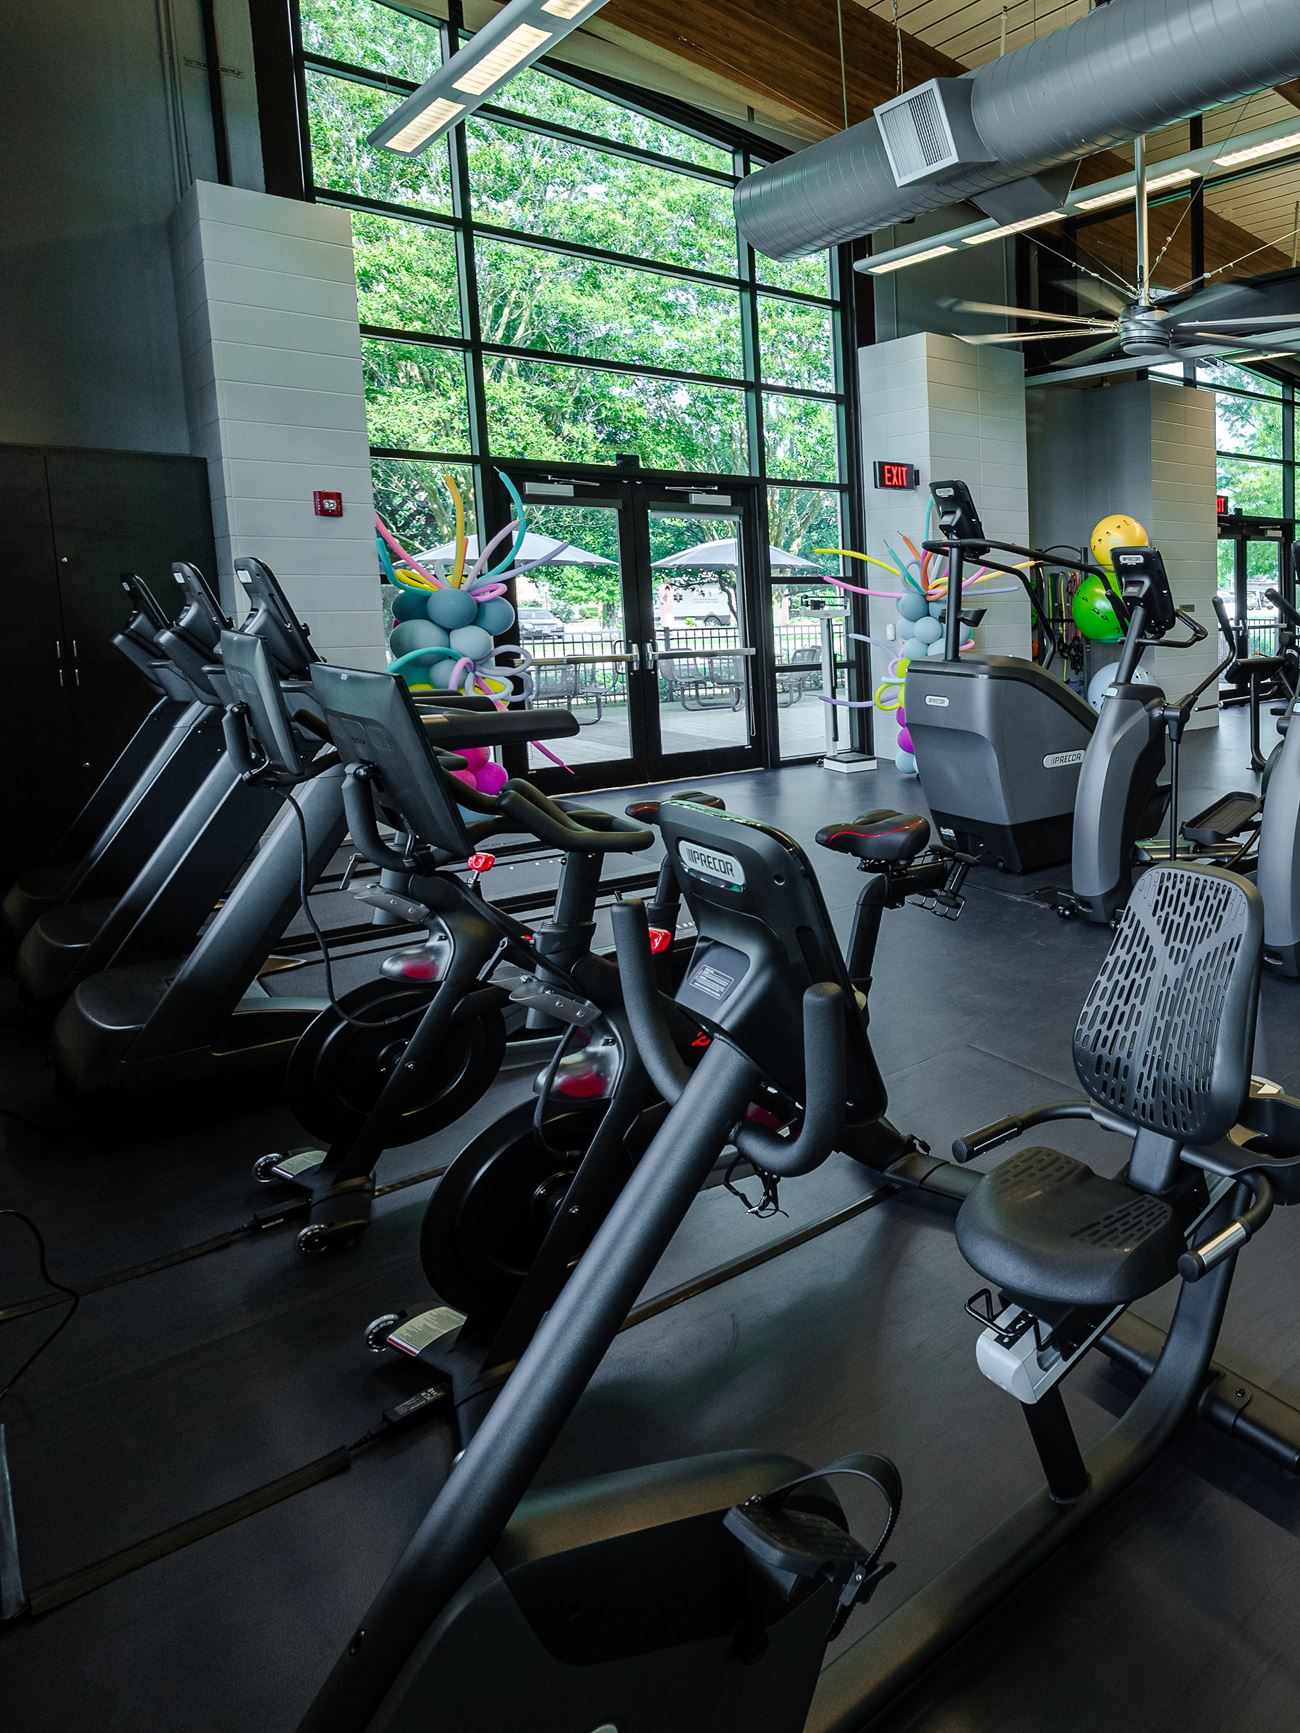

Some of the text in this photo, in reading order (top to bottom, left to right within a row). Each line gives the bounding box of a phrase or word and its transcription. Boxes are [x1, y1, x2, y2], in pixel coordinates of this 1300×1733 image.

[884, 465, 907, 487] EXIT
[1055, 753, 1082, 765] PRECOR
[692, 848, 735, 878] PRECOR
